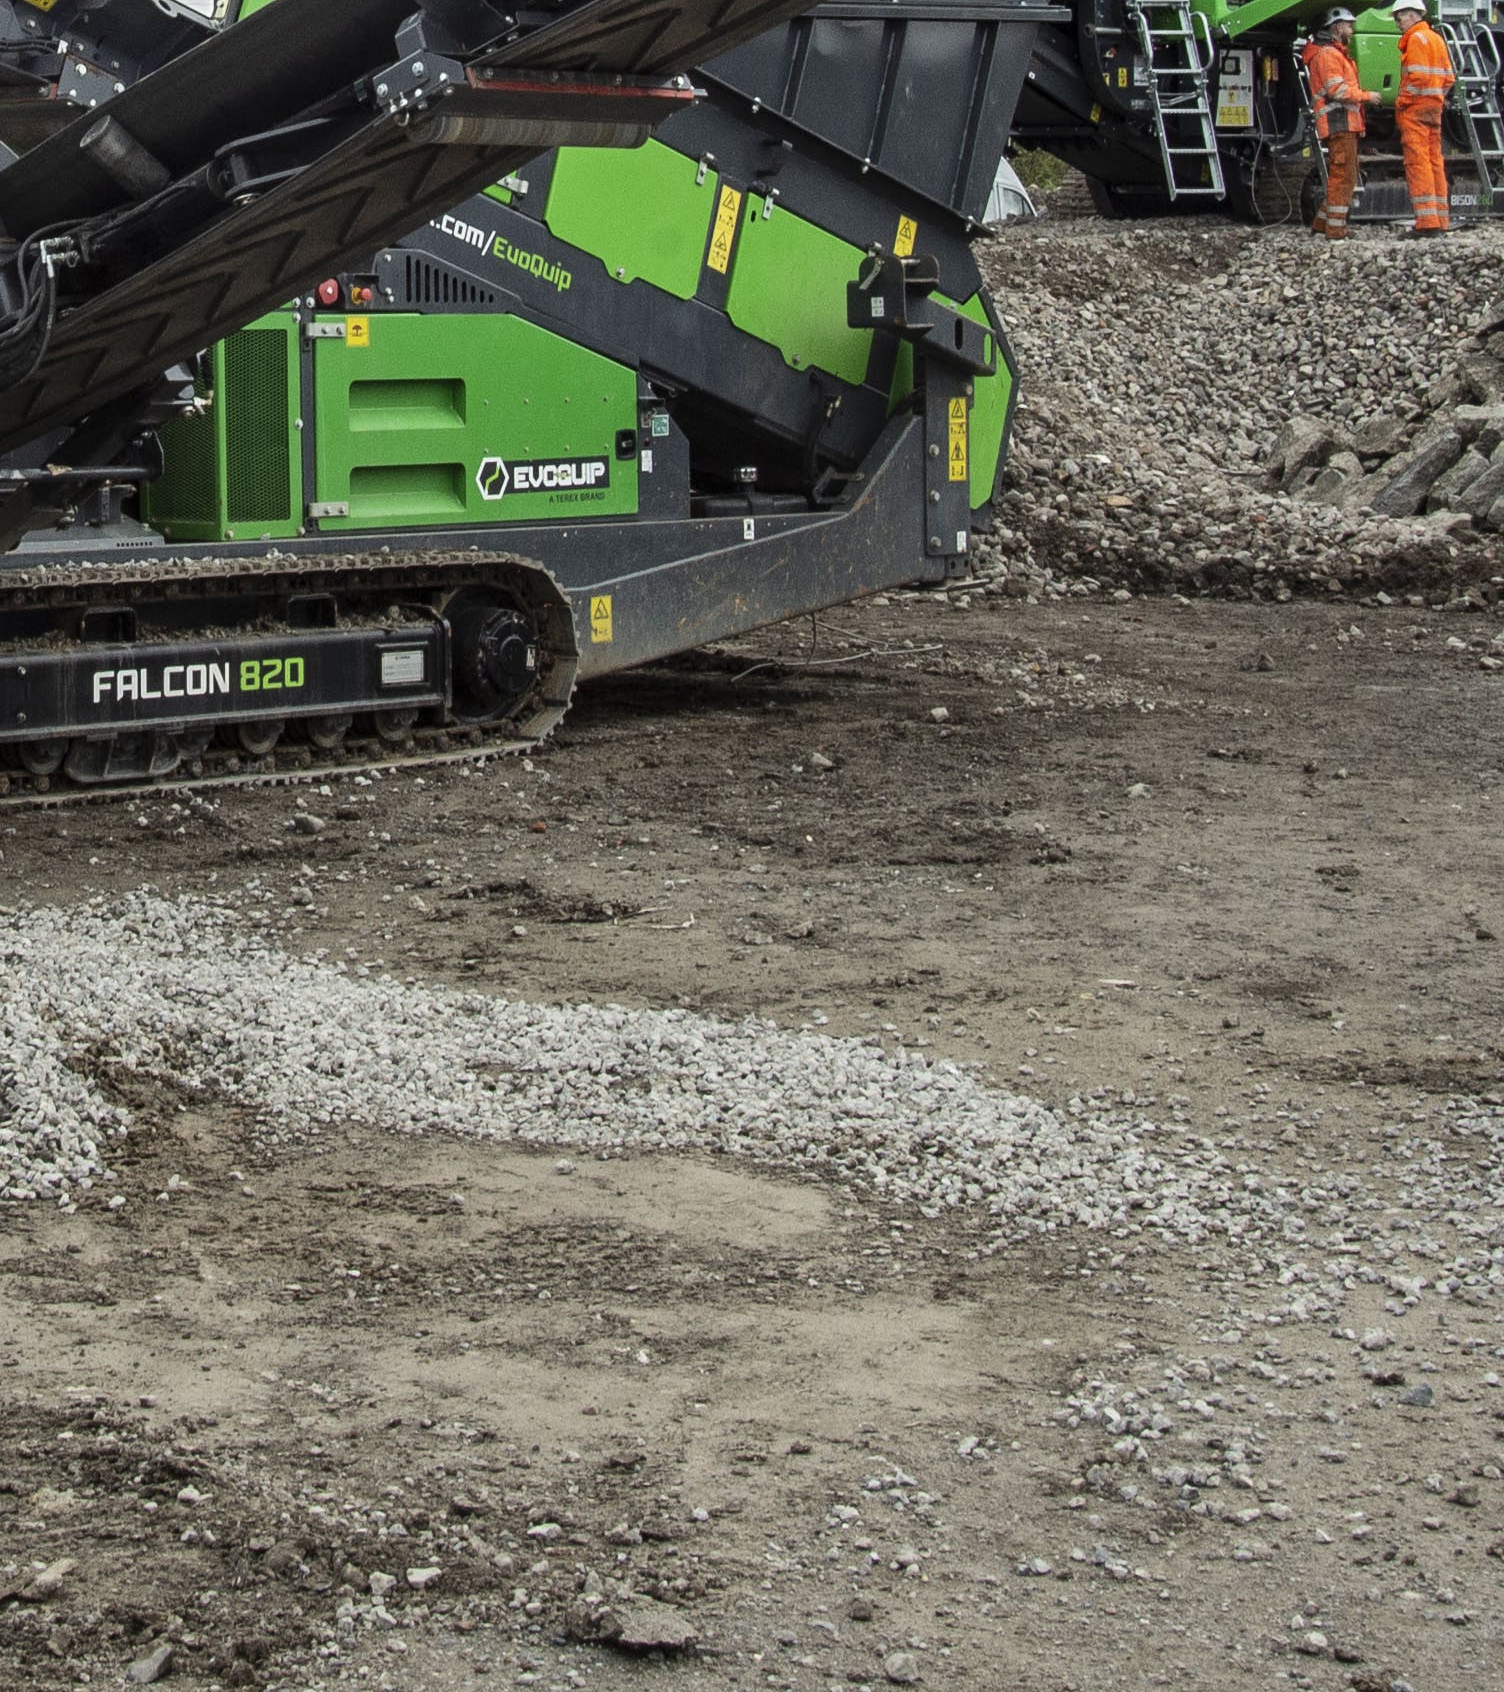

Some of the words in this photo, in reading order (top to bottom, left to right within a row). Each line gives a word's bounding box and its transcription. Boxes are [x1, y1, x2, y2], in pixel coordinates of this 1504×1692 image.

[1450, 194, 1477, 206] BISON
[429, 213, 572, 293] .com/EvoQuip
[513, 461, 606, 490] EVOQUIP
[548, 495, 554, 504] A
[93, 661, 230, 704] FALCON
[240, 657, 305, 691] 820
